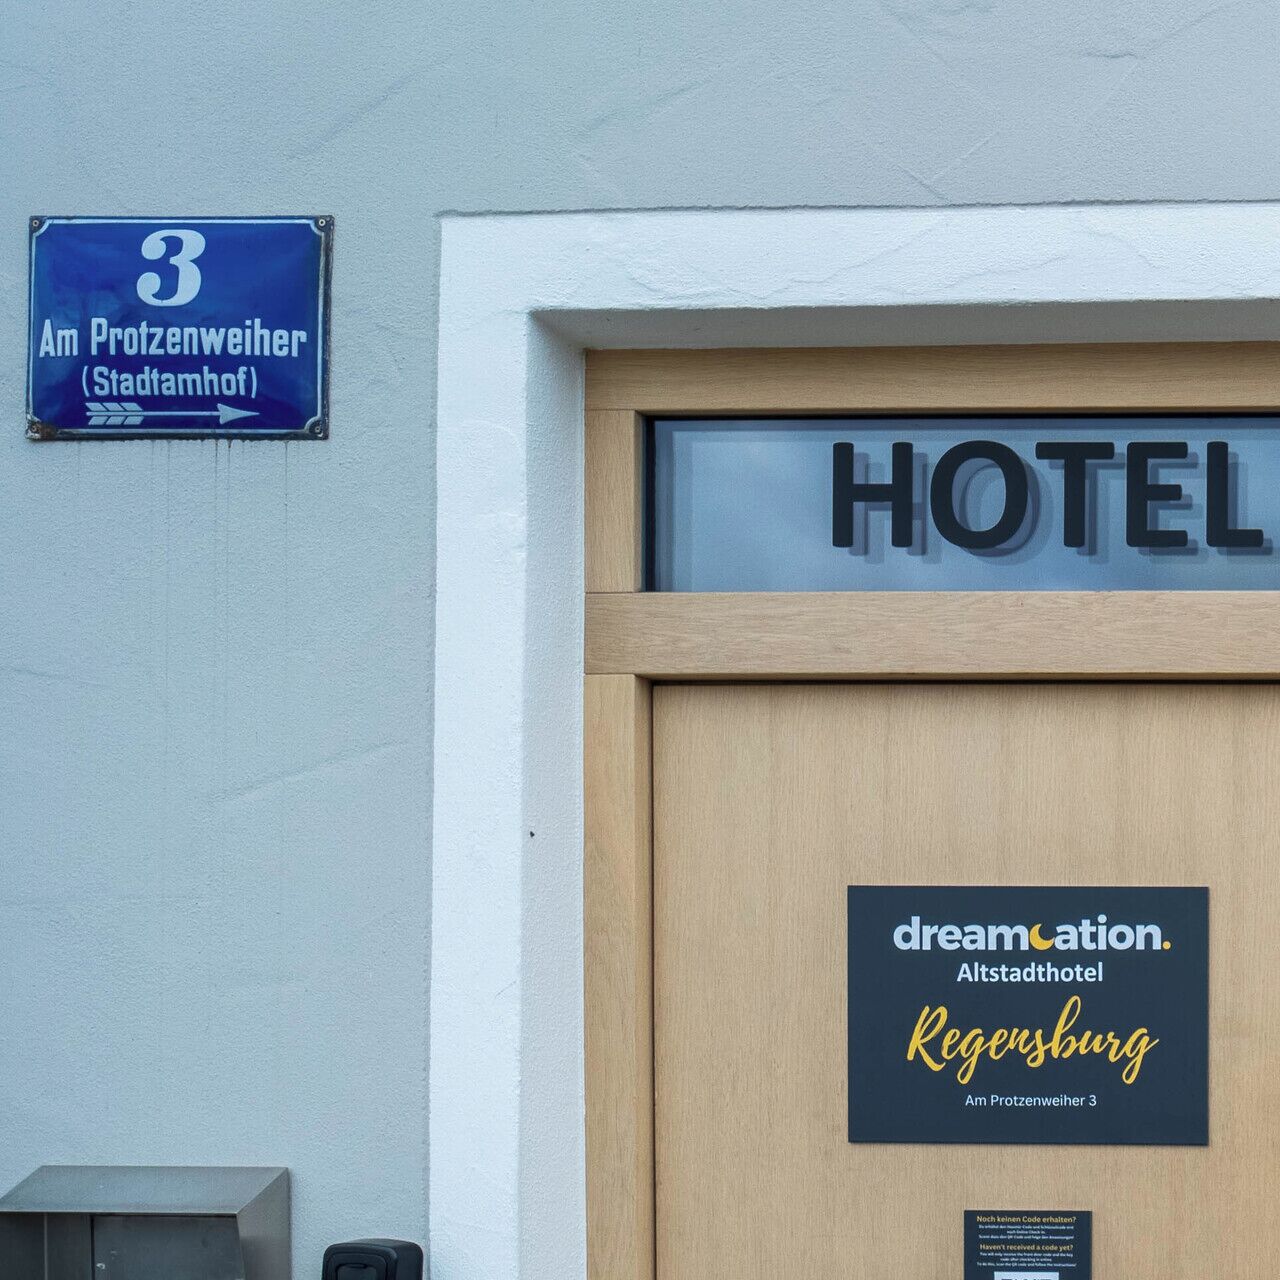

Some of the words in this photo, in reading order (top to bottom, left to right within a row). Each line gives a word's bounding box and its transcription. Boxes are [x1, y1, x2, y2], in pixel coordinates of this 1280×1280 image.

[136, 229, 206, 307] 3
[39, 318, 79, 358] Am
[91, 317, 307, 358] Protzenweiher
[82, 365, 258, 398] (Stadtamhof)
[832, 439, 1264, 549] HOTEL
[956, 961, 1104, 983] Altstadthotel
[906, 995, 1160, 1085] Regensburg
[965, 1095, 987, 1107] Am
[990, 1094, 1086, 1108] Protzenweiher
[1088, 1095, 1097, 1107] 3
[976, 1215, 996, 1223] Noch
[997, 1215, 1021, 1223] keinen
[1022, 1215, 1041, 1223] Code
[1042, 1215, 1077, 1223] erhalten?
